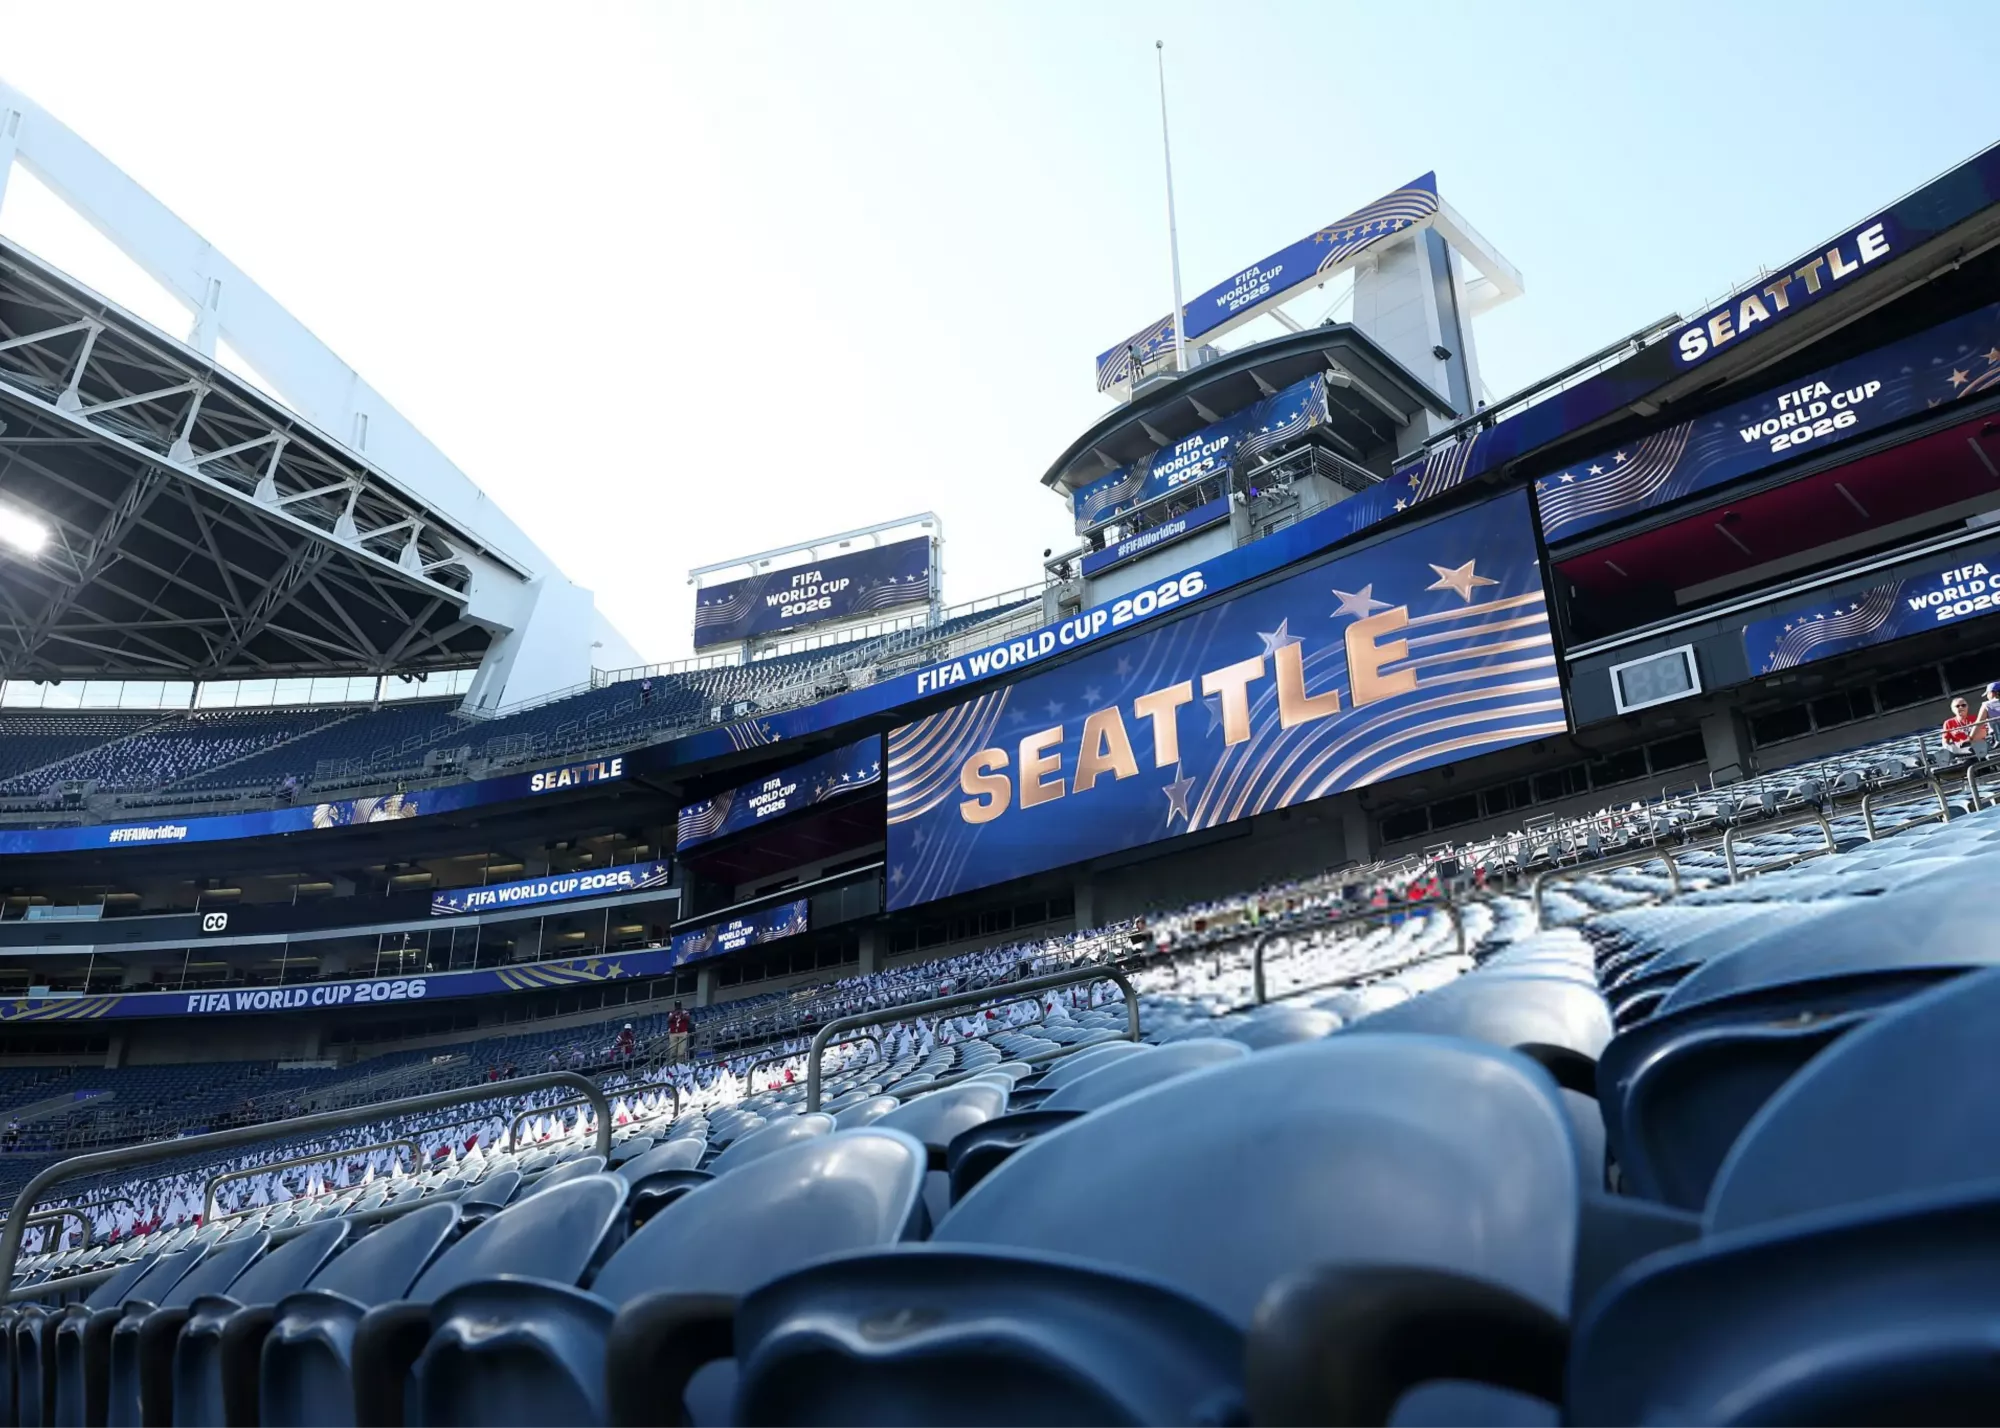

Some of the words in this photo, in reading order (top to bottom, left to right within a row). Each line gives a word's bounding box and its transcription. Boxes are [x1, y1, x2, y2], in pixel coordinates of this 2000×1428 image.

[1216, 279, 1258, 307] WORLD
[1259, 265, 1283, 283] CUP
[1235, 266, 1261, 286] FIFA
[1229, 283, 1270, 311] 2026
[1679, 223, 1890, 361] SEATTLE
[1777, 381, 1832, 411] FIFA
[1740, 401, 1827, 443] WORLD
[1831, 380, 1881, 410] CUP
[1770, 410, 1857, 453] 2026
[1152, 450, 1200, 479] WORLD
[1202, 435, 1229, 456] CUP
[1175, 435, 1204, 457] FIFA
[1118, 520, 1186, 557] #FIFAWorldCup
[792, 571, 823, 588] FIFA
[1941, 562, 1989, 586] FIFA
[766, 585, 818, 607] WORLD
[820, 578, 850, 594] CUP
[1908, 580, 1986, 611] WORLD
[781, 597, 831, 618] 2026
[917, 662, 966, 694] FIFA
[968, 631, 1056, 677] WORLD
[1059, 610, 1107, 645] CUP
[1112, 571, 1205, 626] 2026
[958, 604, 1418, 824] SEATTLE
[530, 757, 623, 792] SEATTLE
[763, 778, 781, 792] FIFA
[749, 790, 779, 809] WORLD
[779, 783, 797, 798] CUP
[756, 799, 786, 818] 2026
[109, 825, 187, 843] #FIFAWorldCup
[466, 889, 496, 910] FIFA
[497, 883, 548, 902] WORLD
[549, 878, 579, 895] CUP
[580, 870, 632, 890] 2026
[205, 915, 225, 930] CC
[718, 929, 741, 942] WORLD
[741, 926, 754, 936] CUP
[729, 920, 742, 930] FIFA
[724, 937, 746, 950] 2026
[187, 994, 231, 1012] FIFA
[236, 989, 309, 1011] WORLD
[311, 985, 352, 1006] CUP
[353, 979, 427, 1002] 2026
